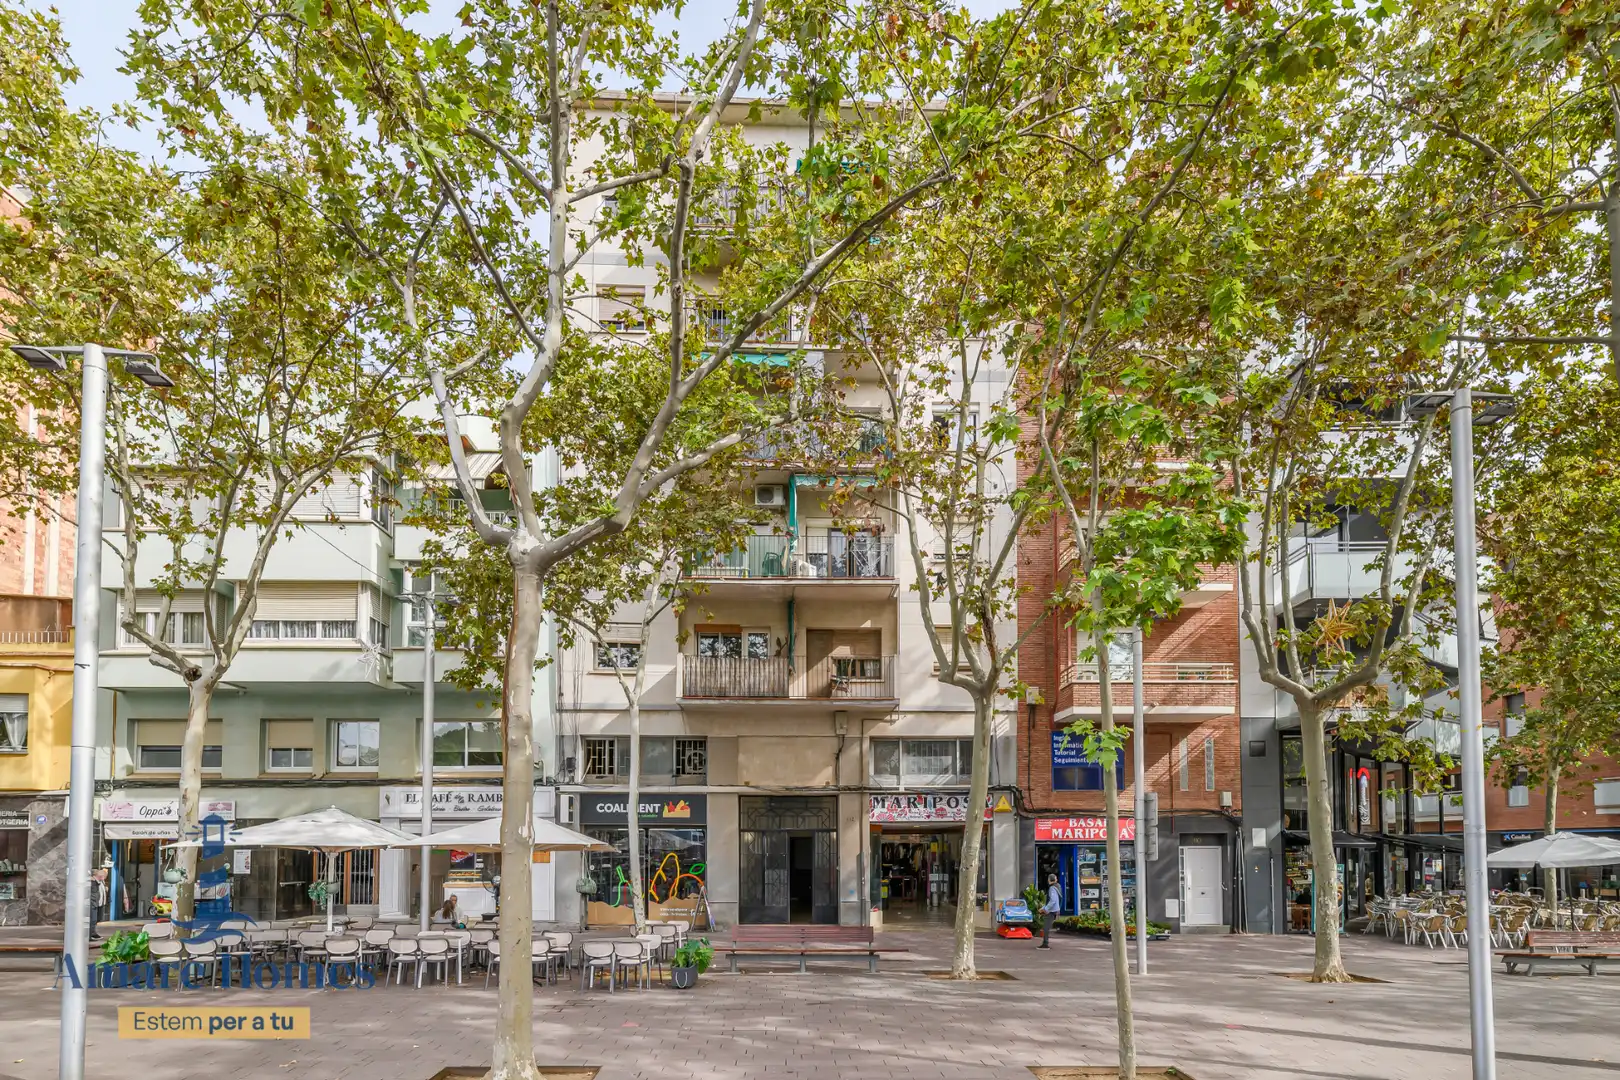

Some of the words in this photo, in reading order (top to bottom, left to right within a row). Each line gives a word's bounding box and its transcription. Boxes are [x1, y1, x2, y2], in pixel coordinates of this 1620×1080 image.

[406, 794, 419, 803] EL
[468, 793, 503, 803] RAMB
[596, 803, 661, 813] COALIENT
[1069, 818, 1107, 827] BASA
[1052, 828, 1129, 838] MARIPOA
